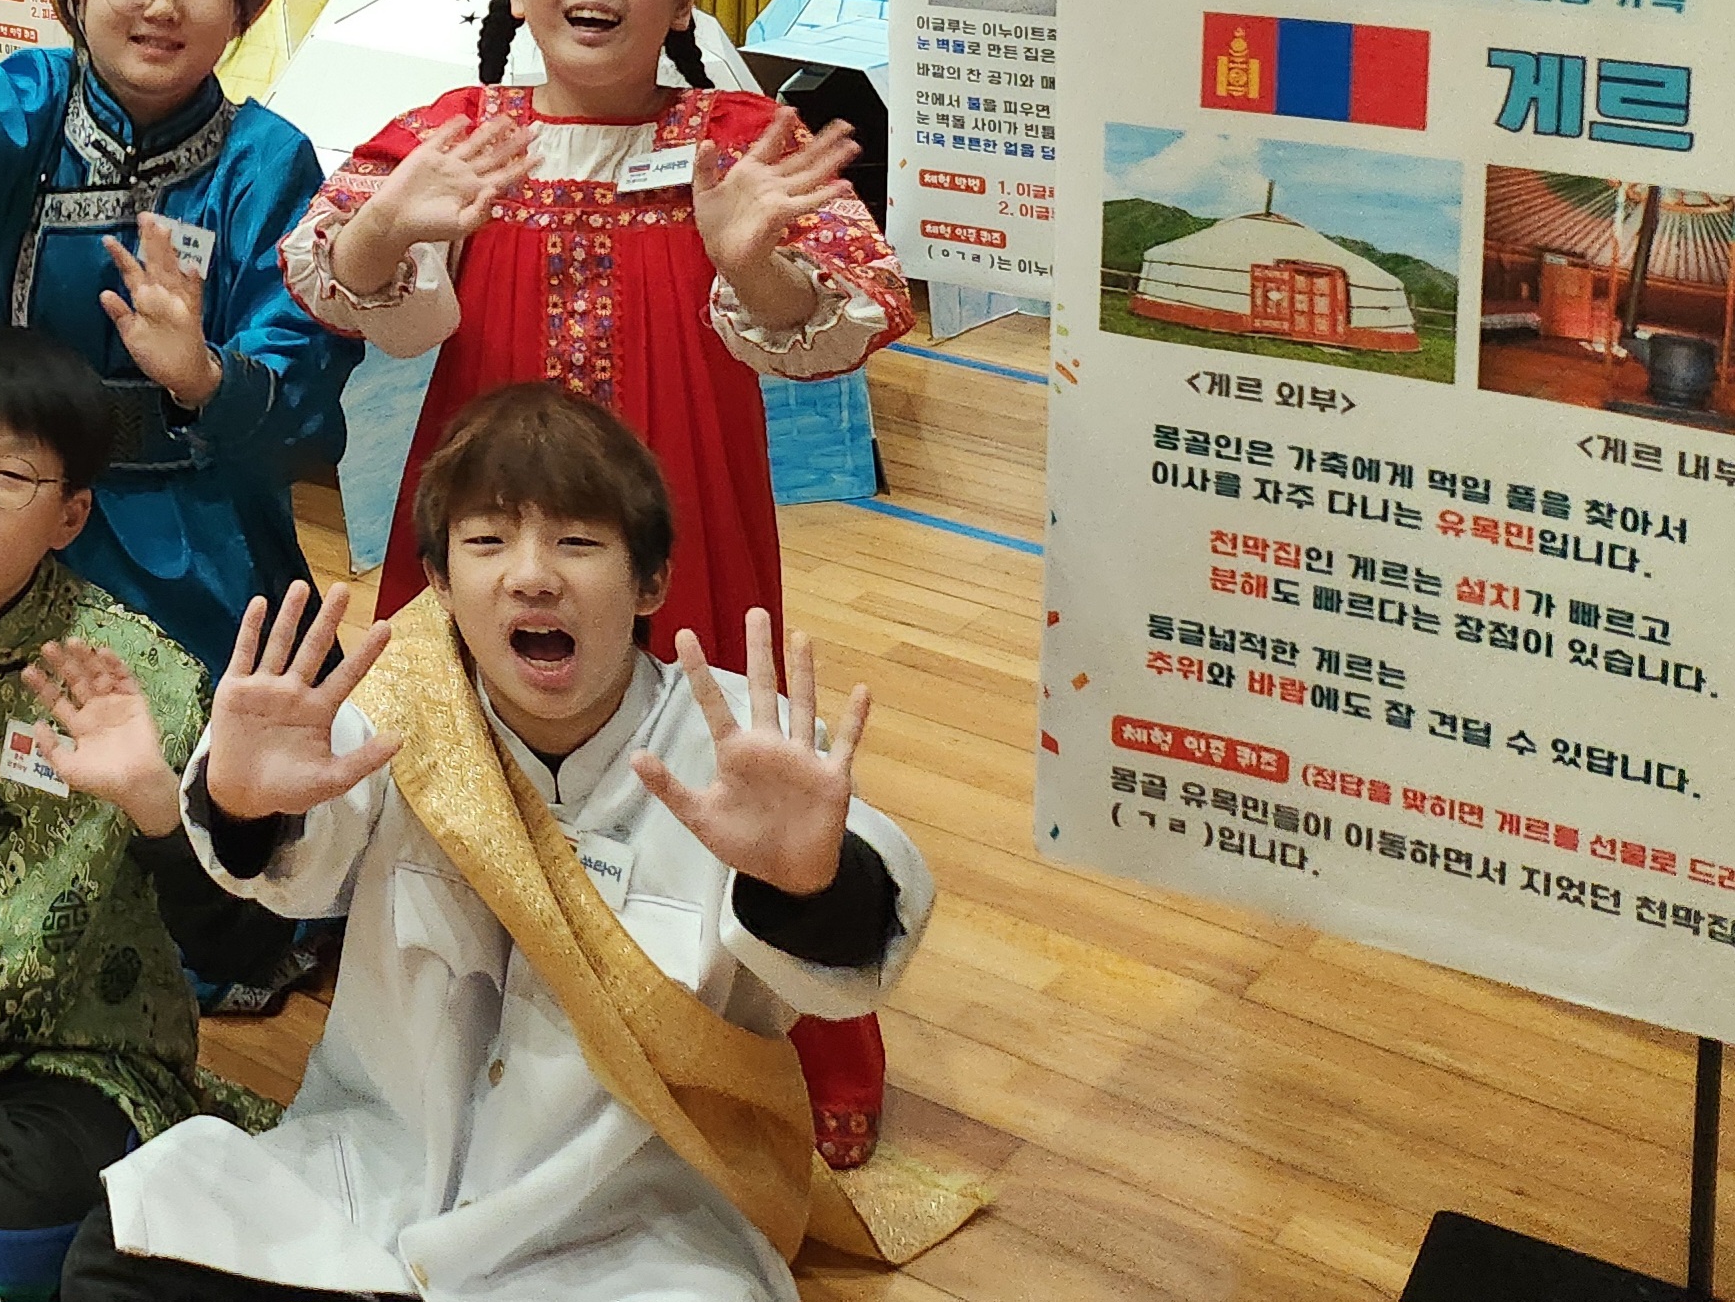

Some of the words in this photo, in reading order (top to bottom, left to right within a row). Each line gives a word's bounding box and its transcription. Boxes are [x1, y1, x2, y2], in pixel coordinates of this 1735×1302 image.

[916, 15, 977, 35] 이글루는
[916, 36, 931, 51] 눈
[936, 38, 982, 56] 벽돌로
[987, 42, 1018, 60] 만든
[1024, 47, 1056, 64] 집은
[916, 62, 961, 81] 바깥의
[966, 68, 981, 83] 찬
[987, 71, 1034, 89] 공기와
[916, 90, 961, 109] 안에서
[1003, 101, 1051, 120] 피우면
[1487, 47, 1694, 152] 게르
[916, 111, 930, 126] 눈
[936, 113, 966, 130] 벽돌
[971, 117, 1018, 136] 사이가
[916, 130, 946, 148] 더욱
[952, 135, 998, 155] 튼튼한
[1004, 141, 1035, 159] 얼음
[924, 172, 952, 188] 체험
[954, 176, 981, 192] 방법
[998, 180, 1011, 197] 1.
[998, 200, 1014, 217] 2.
[925, 223, 952, 239] 체험
[954, 227, 977, 243] 인증
[980, 229, 1002, 245] 퀴즈
[1186, 370, 1264, 403] <게르
[1276, 381, 1357, 415] 외부>
[1575, 435, 1663, 471] <게르
[1152, 423, 1275, 467] 몽골인은
[1287, 443, 1414, 491] 가축에게
[1428, 468, 1492, 503] 먹일
[1505, 482, 1571, 518] 풀을
[1584, 497, 1689, 545] 찾아서
[1151, 460, 1241, 499] 이사를
[1252, 478, 1317, 511] 자주
[1327, 491, 1423, 529] 다니는
[1434, 509, 1654, 579] 유목민입니다.
[1208, 528, 1335, 574] 천막집인
[1347, 552, 1443, 597] 게르는
[1455, 574, 1556, 619] 설치가
[1567, 597, 1673, 648] 빠르고
[1208, 565, 1301, 607] 분해도
[1312, 585, 1441, 635] 빠르다는
[1454, 613, 1554, 659] 장점이
[1567, 635, 1720, 699] 있습니다.
[1145, 613, 1300, 667] 둥글넓적한
[1314, 646, 1407, 689] 게르는
[1145, 649, 1236, 689] 추위와
[1247, 668, 1372, 718] 바람에도
[1384, 700, 1416, 730] 잘
[1427, 709, 1492, 748] 견딜
[1505, 730, 1538, 758] 수
[1550, 738, 1702, 799] 있답니다.
[1121, 723, 1173, 753] 체험
[1182, 735, 1226, 764] 인증
[1235, 746, 1279, 775] 퀴즈
[1301, 764, 1393, 806] (정답을
[1401, 784, 1485, 829] 맞히면
[1493, 806, 1582, 853] 게르를
[1589, 833, 1678, 876] 선물로
[1110, 765, 1168, 801] 몽골
[1181, 780, 1332, 842] 유목민들이
[1344, 822, 1507, 888] 이동하면서
[1519, 864, 1621, 916] 지었던
[1634, 895, 1735, 946] 천막집
